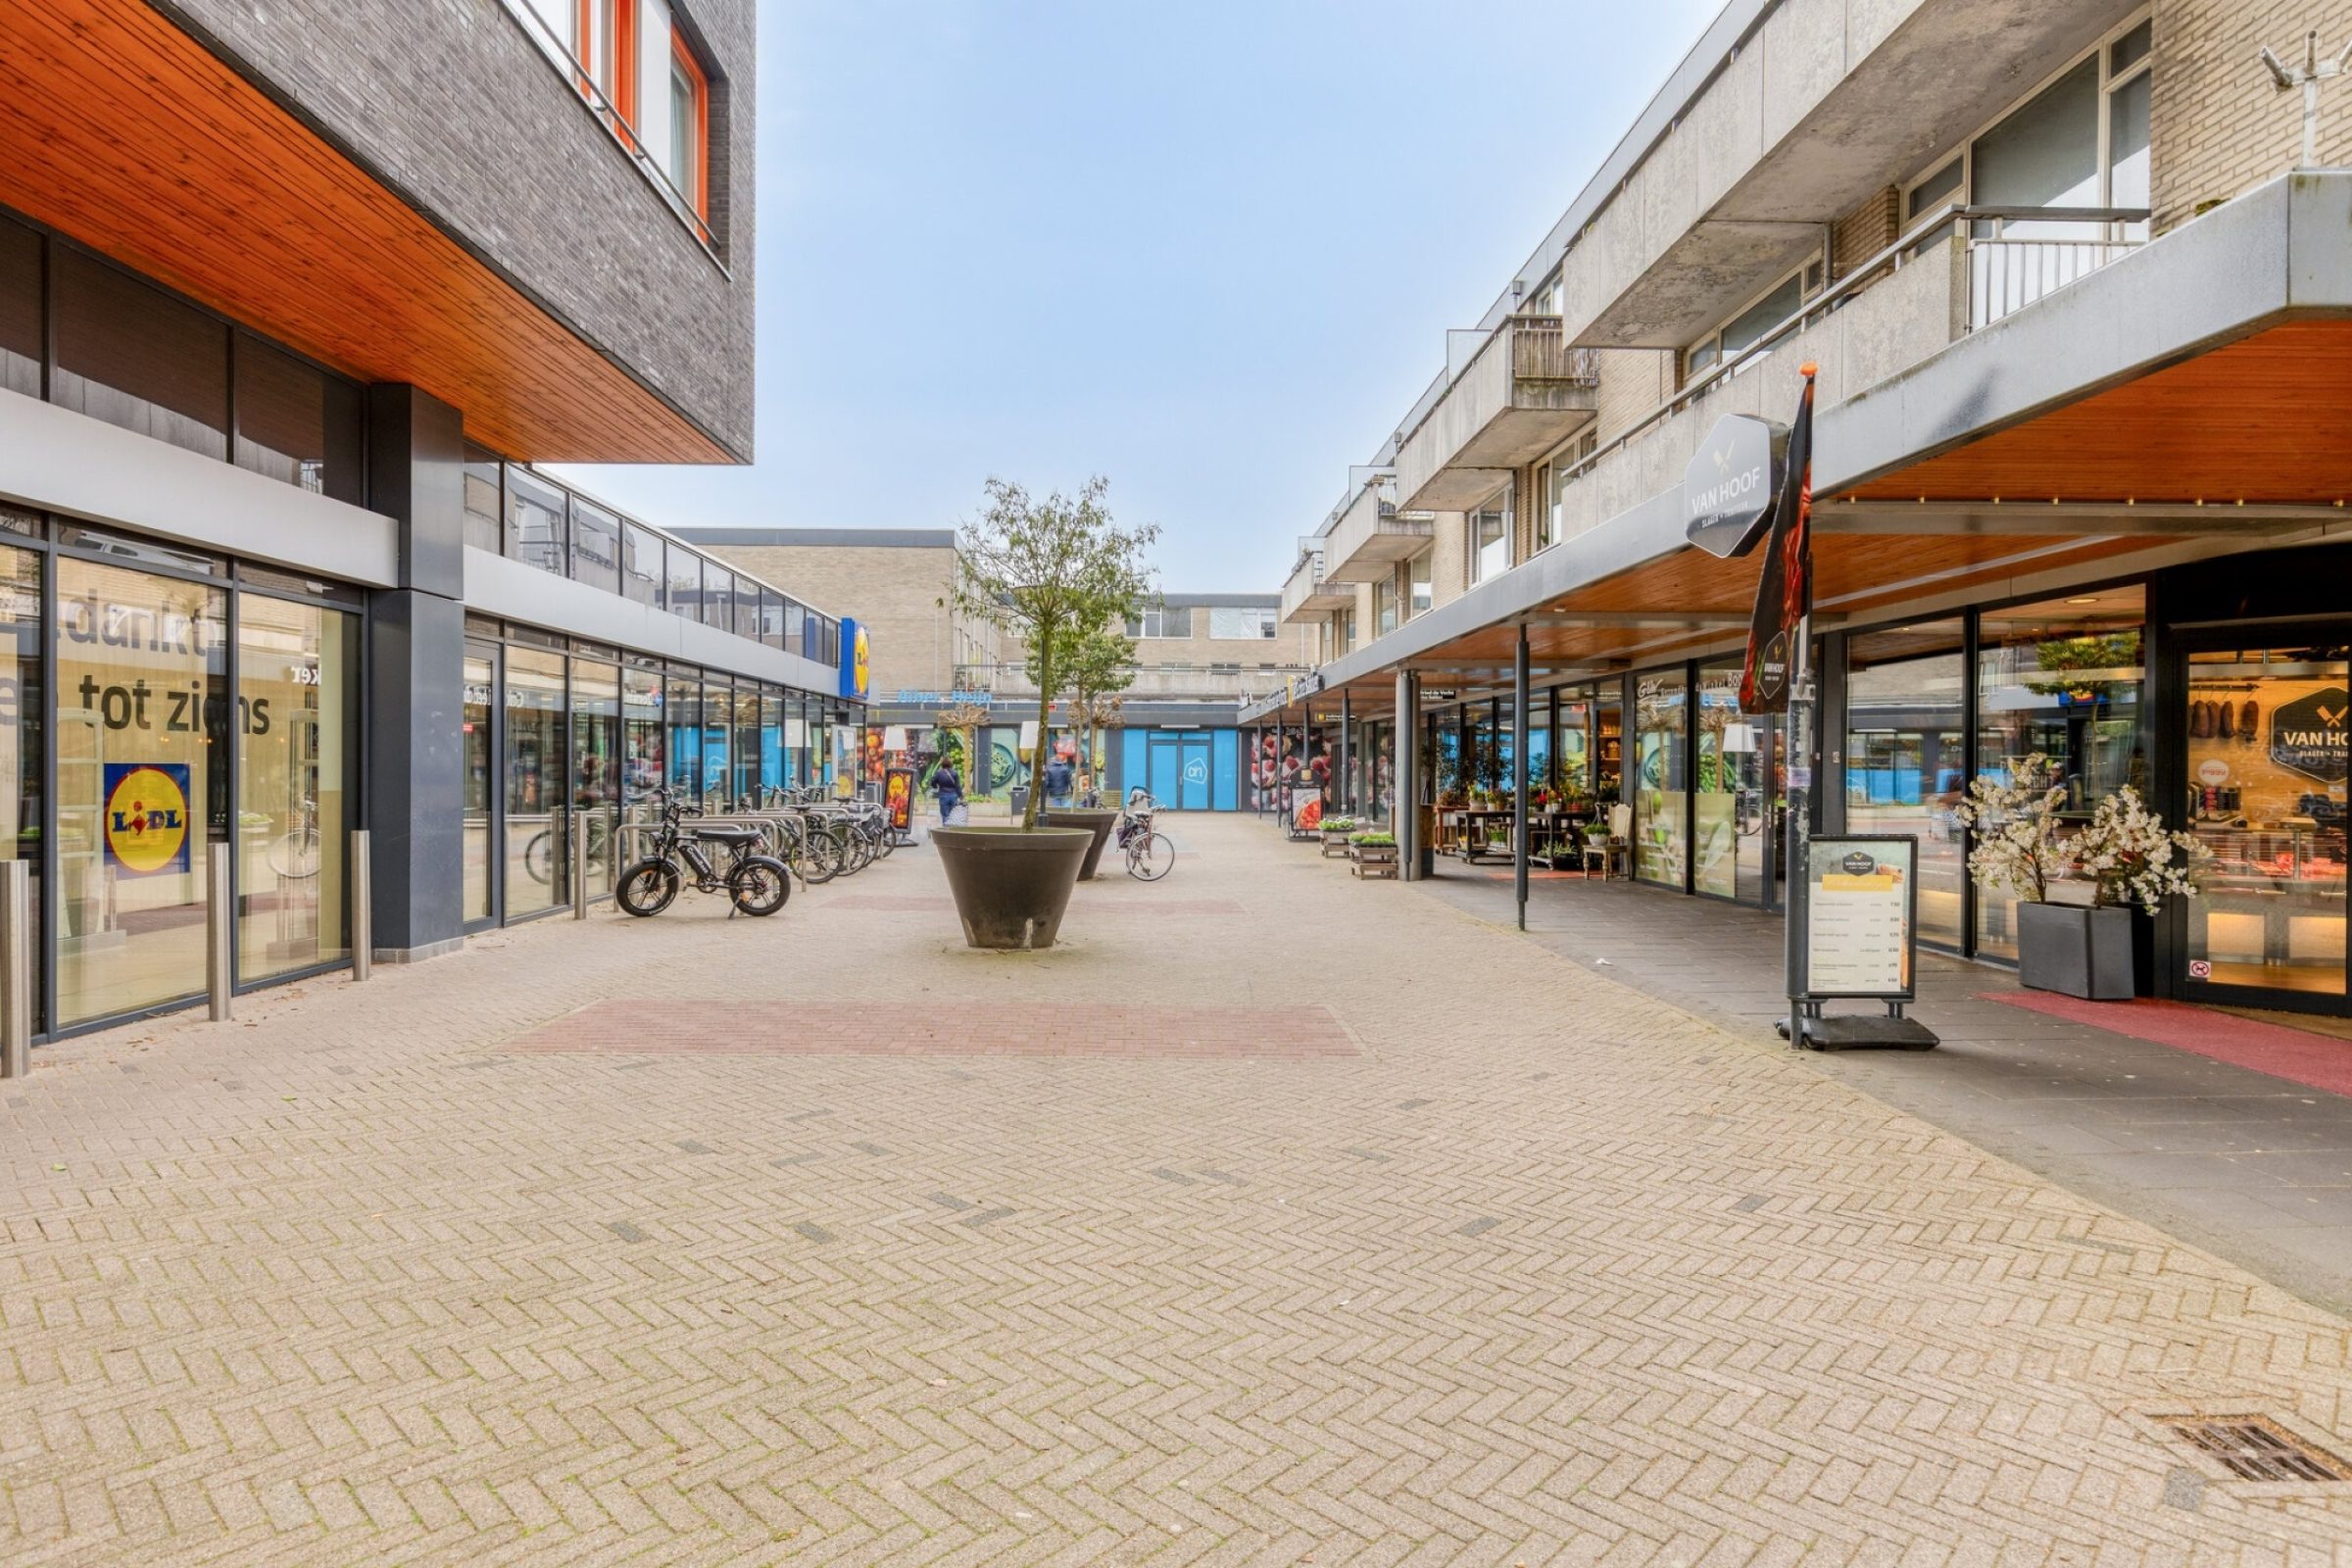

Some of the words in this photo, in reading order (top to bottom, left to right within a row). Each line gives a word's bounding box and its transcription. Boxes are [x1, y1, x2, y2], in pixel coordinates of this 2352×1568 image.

[1691, 487, 1718, 515] VAN
[1719, 466, 1761, 504] HOOF
[56, 588, 206, 657] dankt
[79, 674, 152, 730] tot
[167, 680, 270, 735] zins
[2283, 732, 2323, 746] VAN
[2327, 732, 2349, 746] HO
